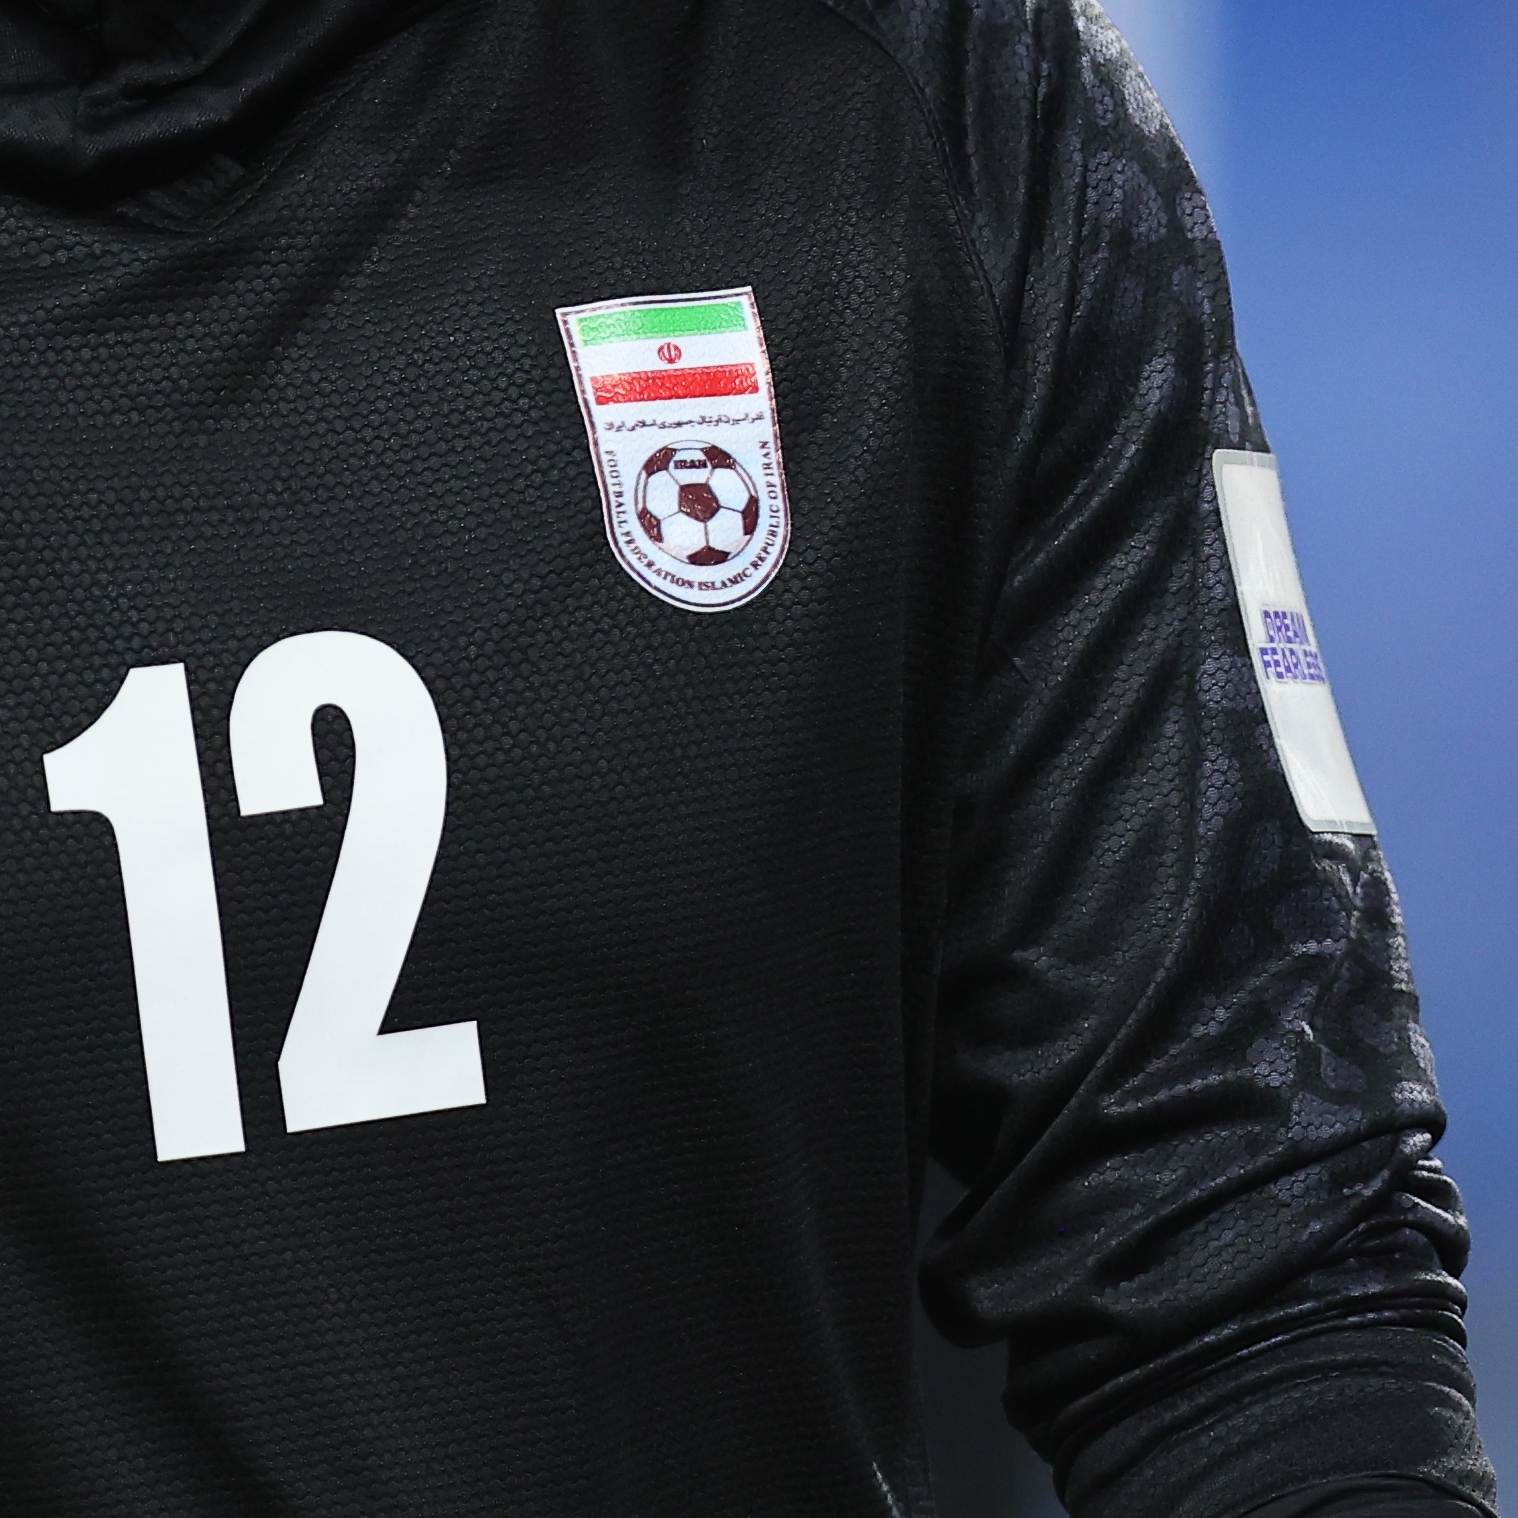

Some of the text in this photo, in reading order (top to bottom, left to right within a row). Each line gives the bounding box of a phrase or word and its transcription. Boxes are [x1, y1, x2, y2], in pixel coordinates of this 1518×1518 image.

[605, 441, 781, 590] FOOTBALL FEDERATION ISLAMIC REPUBLIC OF IRAN
[43, 630, 486, 1161] 12
